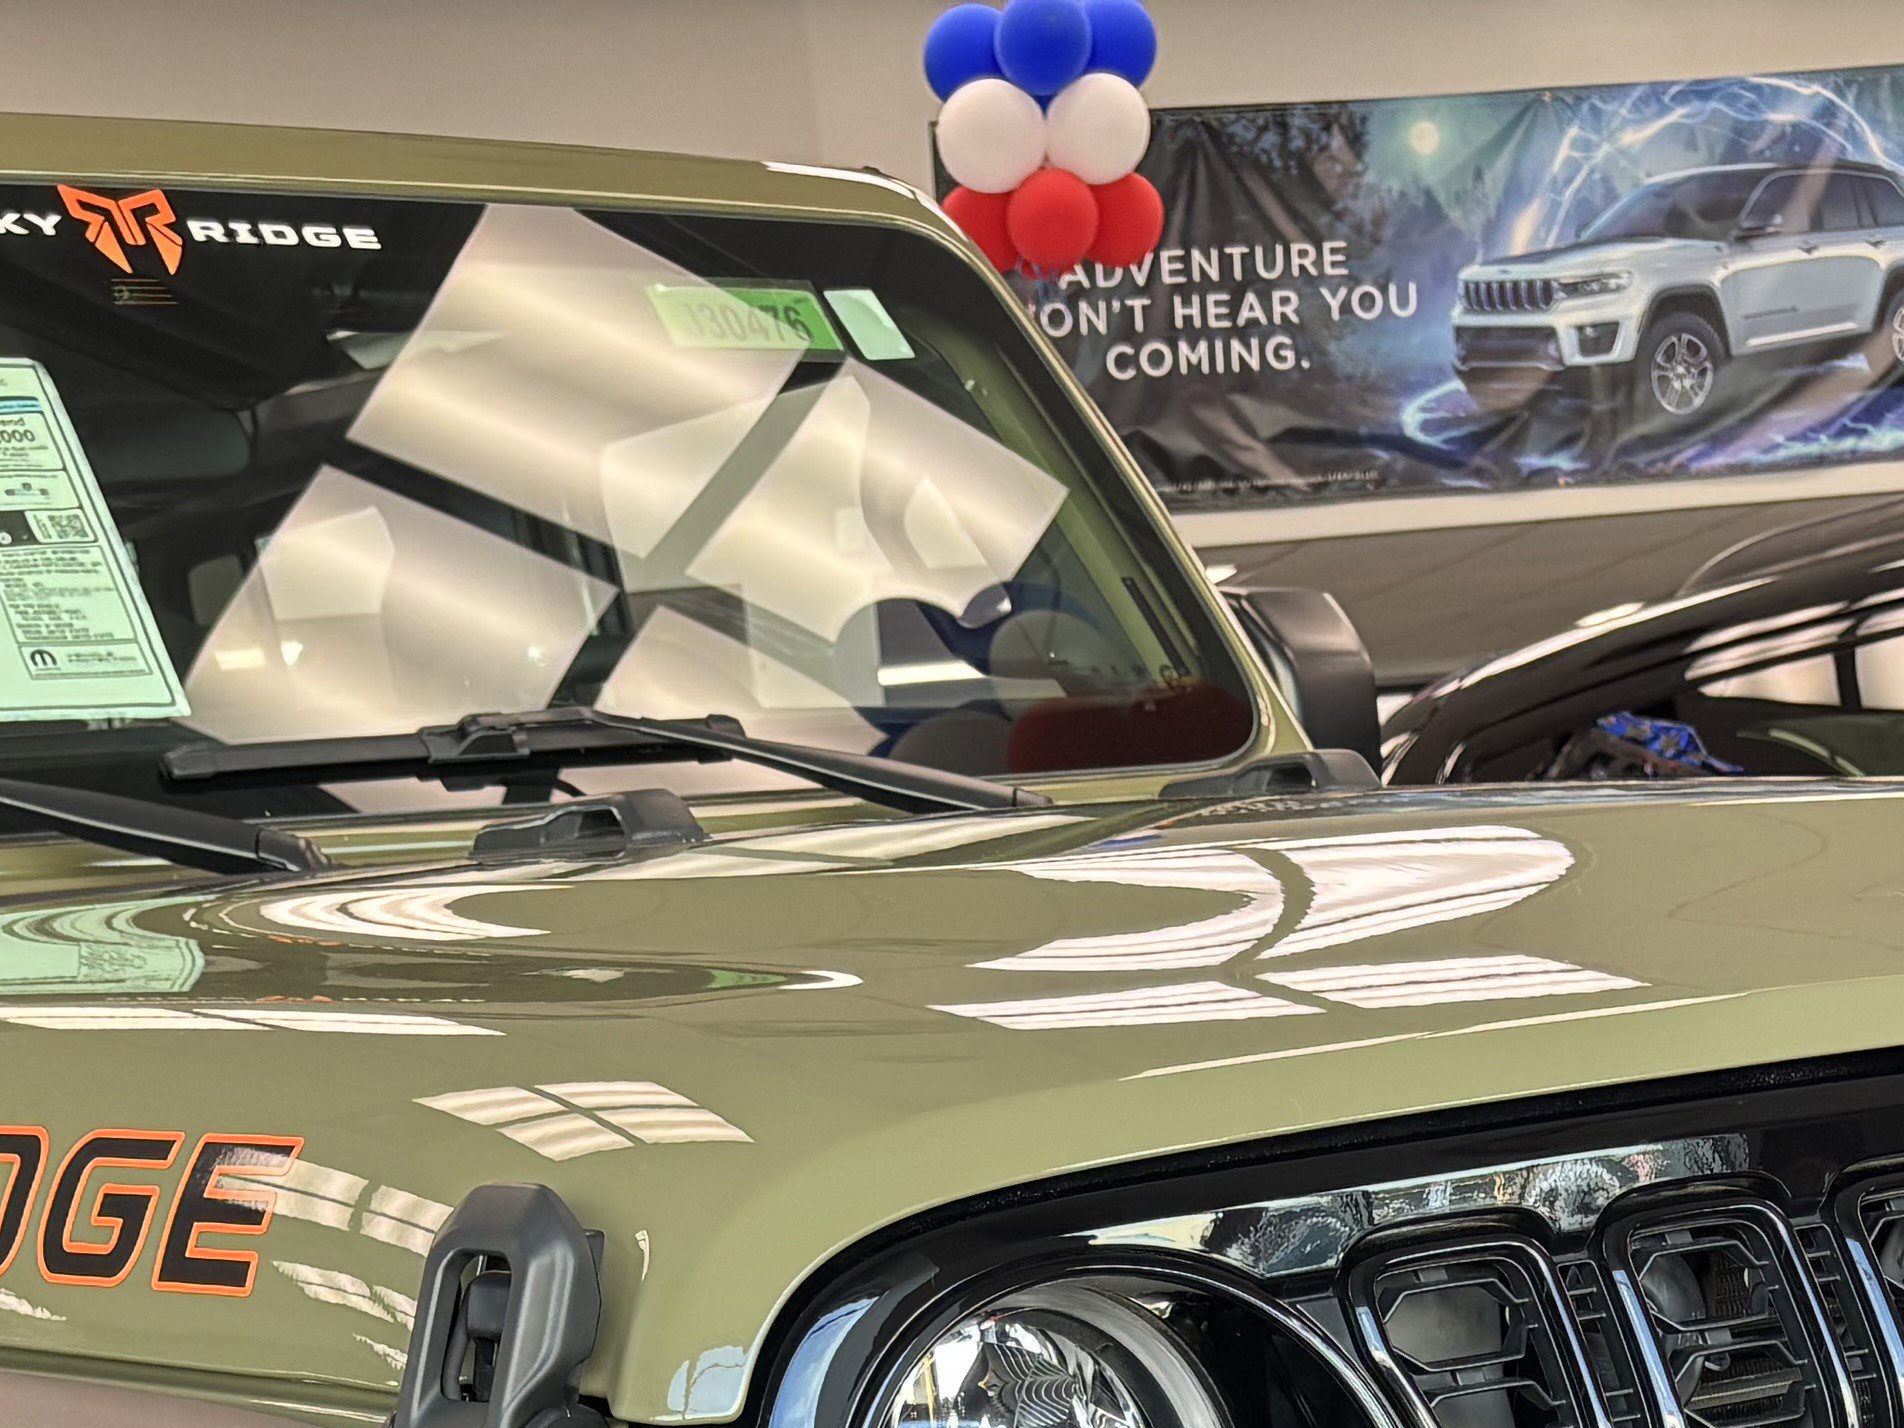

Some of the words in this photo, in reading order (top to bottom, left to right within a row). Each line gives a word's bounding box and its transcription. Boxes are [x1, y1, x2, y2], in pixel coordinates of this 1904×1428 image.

[186, 220, 383, 250] RIDGE
[1028, 297, 1151, 338] ON'T
[1173, 290, 1300, 330] HEAR
[1320, 280, 1419, 322] YOU
[1105, 335, 1312, 382] COMING.
